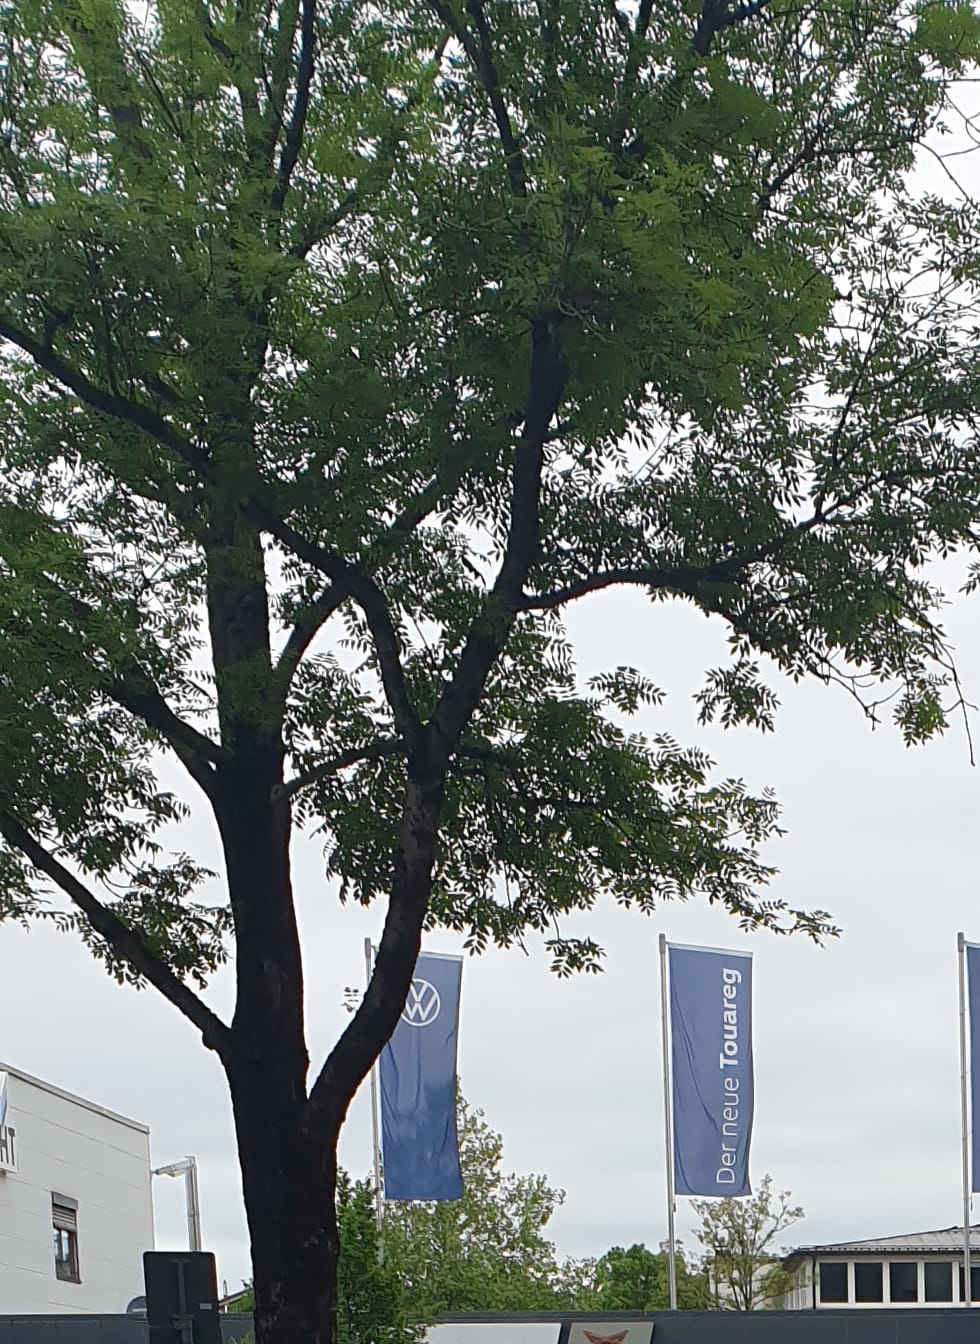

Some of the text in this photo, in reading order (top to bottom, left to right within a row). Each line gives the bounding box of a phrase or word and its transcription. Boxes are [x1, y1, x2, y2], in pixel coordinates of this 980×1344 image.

[716, 968, 742, 1185] Der neue Touareg
